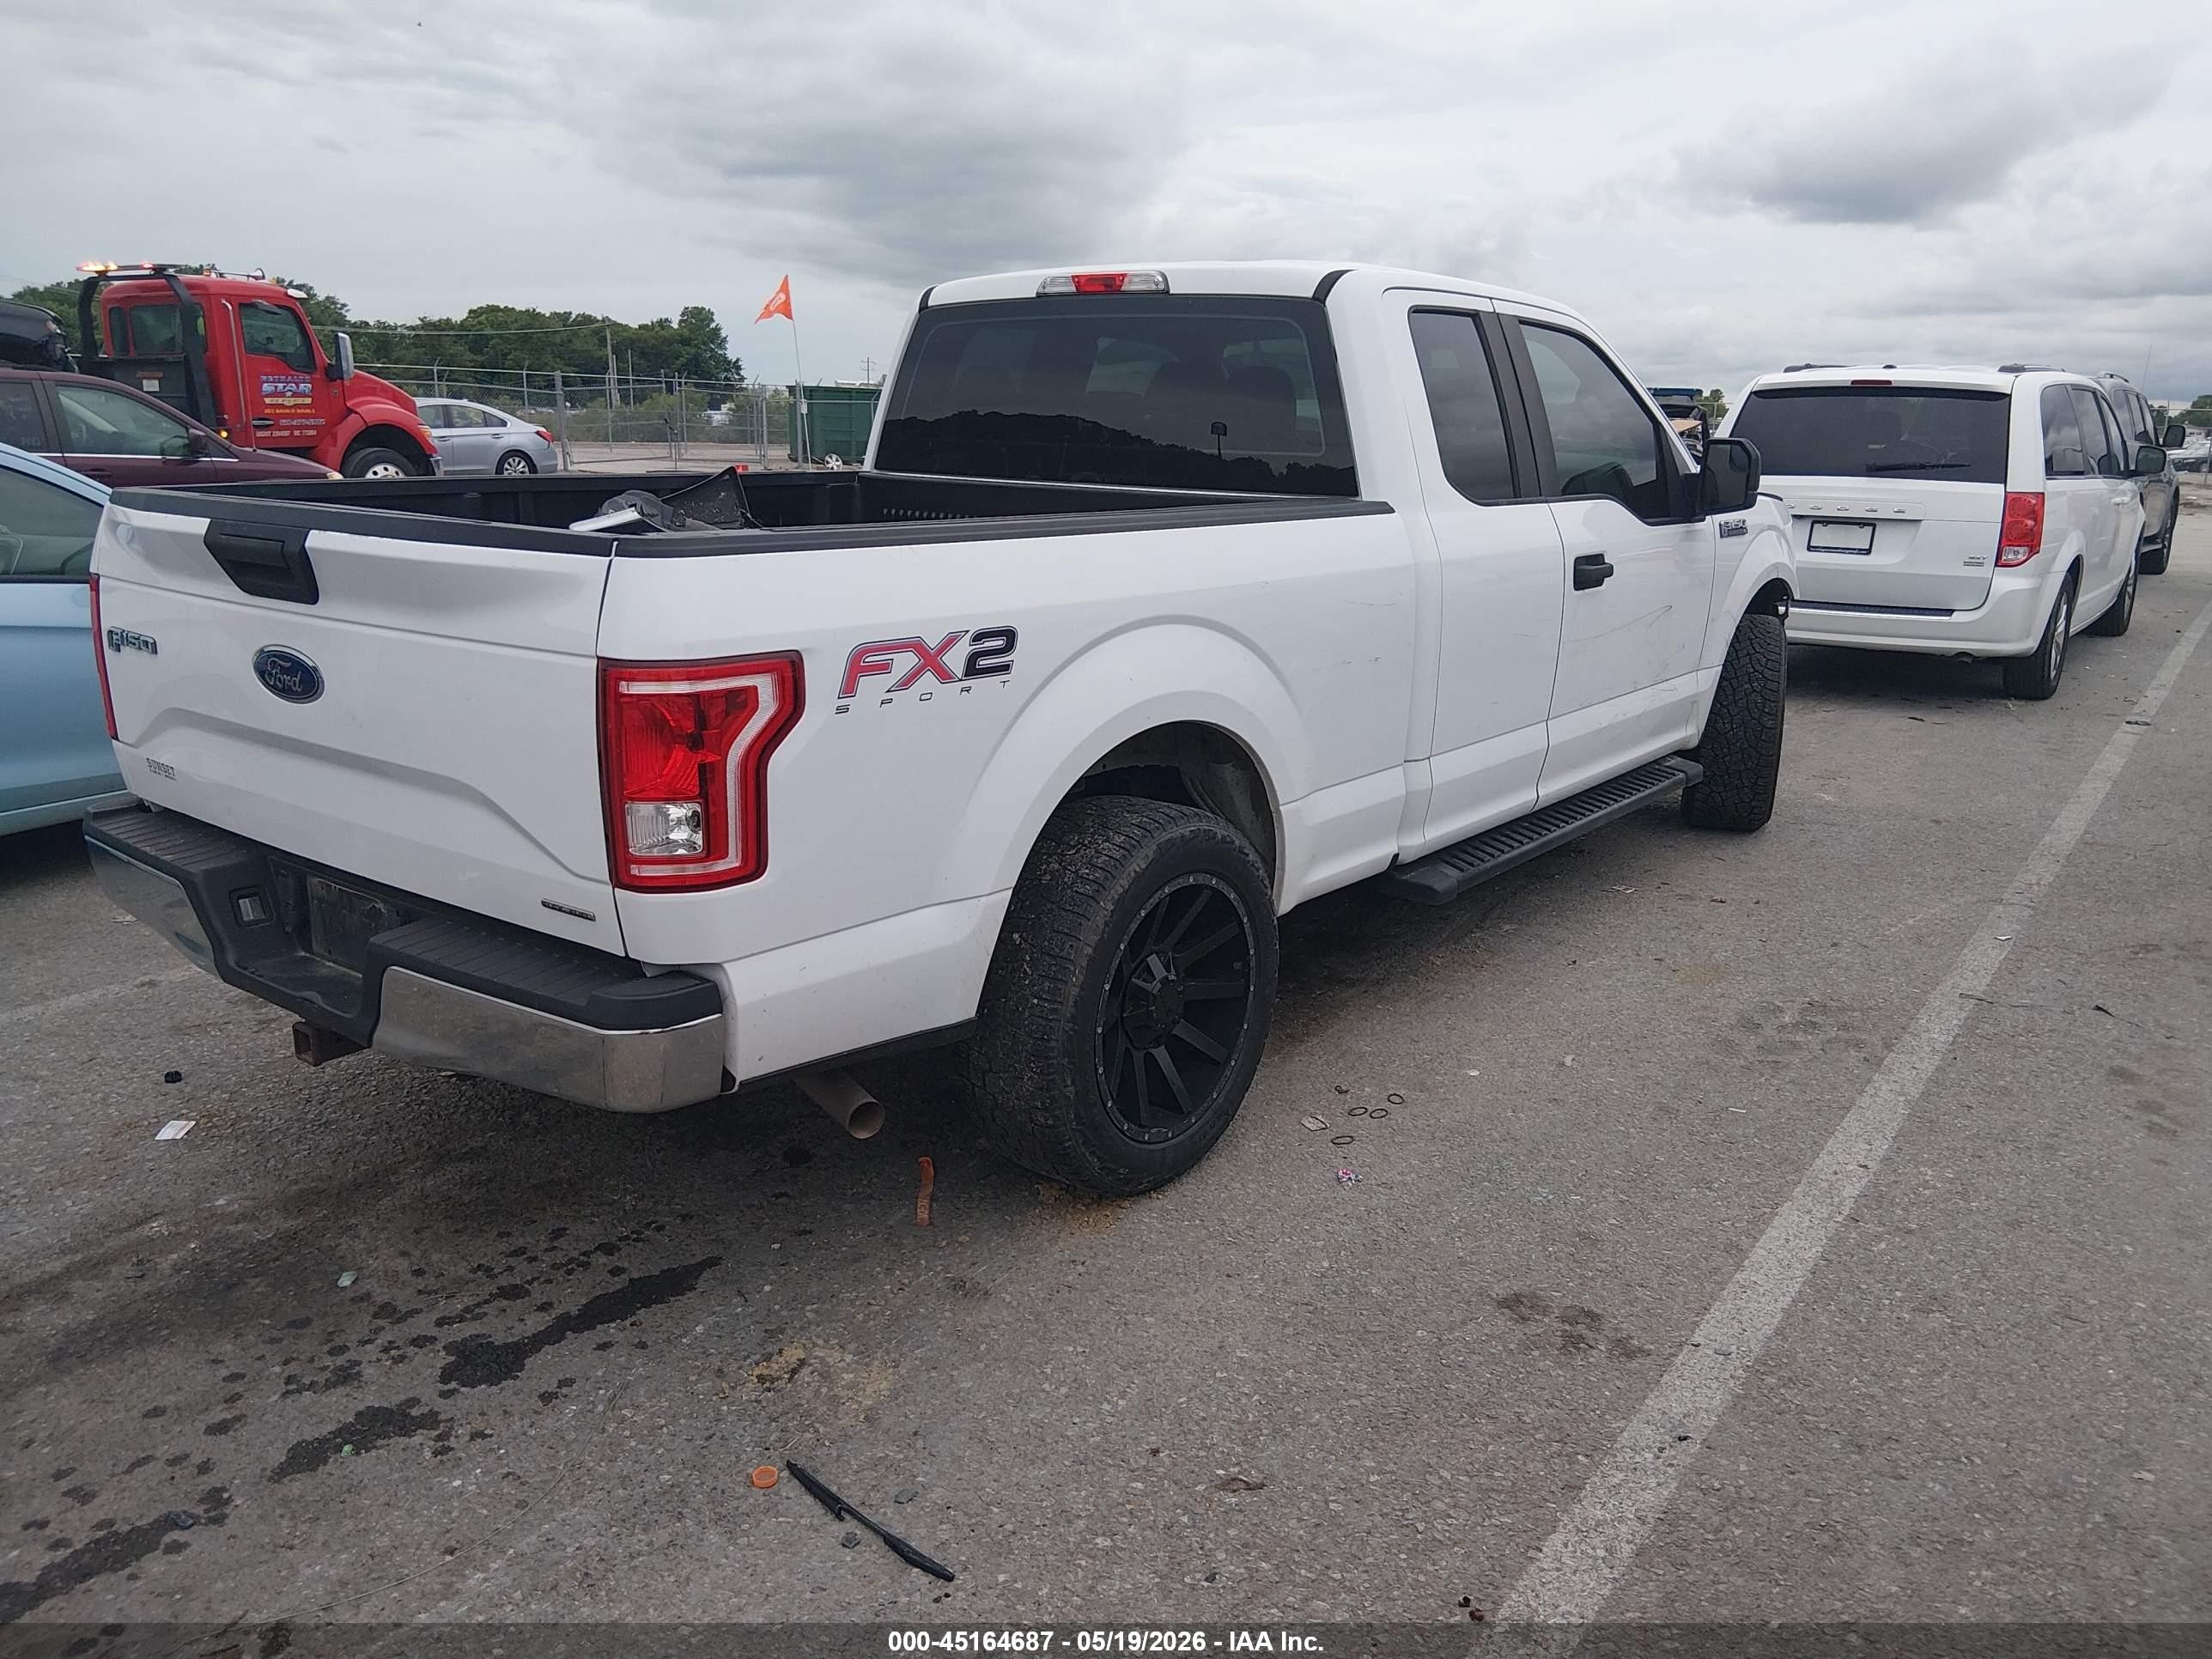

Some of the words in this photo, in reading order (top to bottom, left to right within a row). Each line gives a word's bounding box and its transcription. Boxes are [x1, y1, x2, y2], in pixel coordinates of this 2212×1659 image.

[261, 383, 313, 395] STAR
[264, 657, 303, 693] Ford
[836, 624, 1019, 700] FX2
[834, 679, 1012, 715] SPORT
[146, 757, 176, 777] SUNSET
